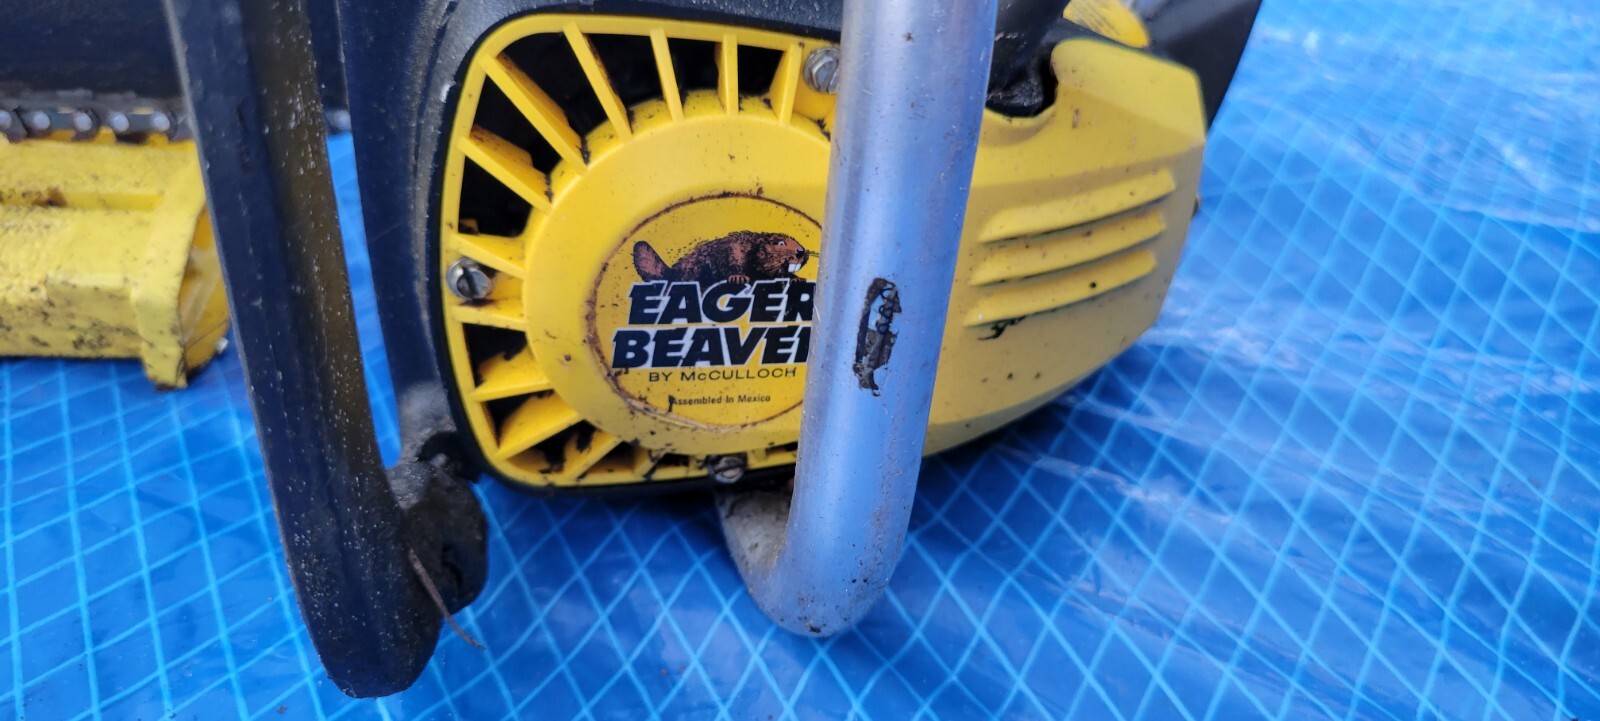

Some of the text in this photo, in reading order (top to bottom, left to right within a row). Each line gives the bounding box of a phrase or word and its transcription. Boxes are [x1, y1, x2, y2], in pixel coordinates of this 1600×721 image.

[629, 279, 816, 323] EAGER
[649, 367, 797, 382] BY McCULLOCH
[726, 395, 734, 403] In
[738, 394, 771, 403] Mexico
